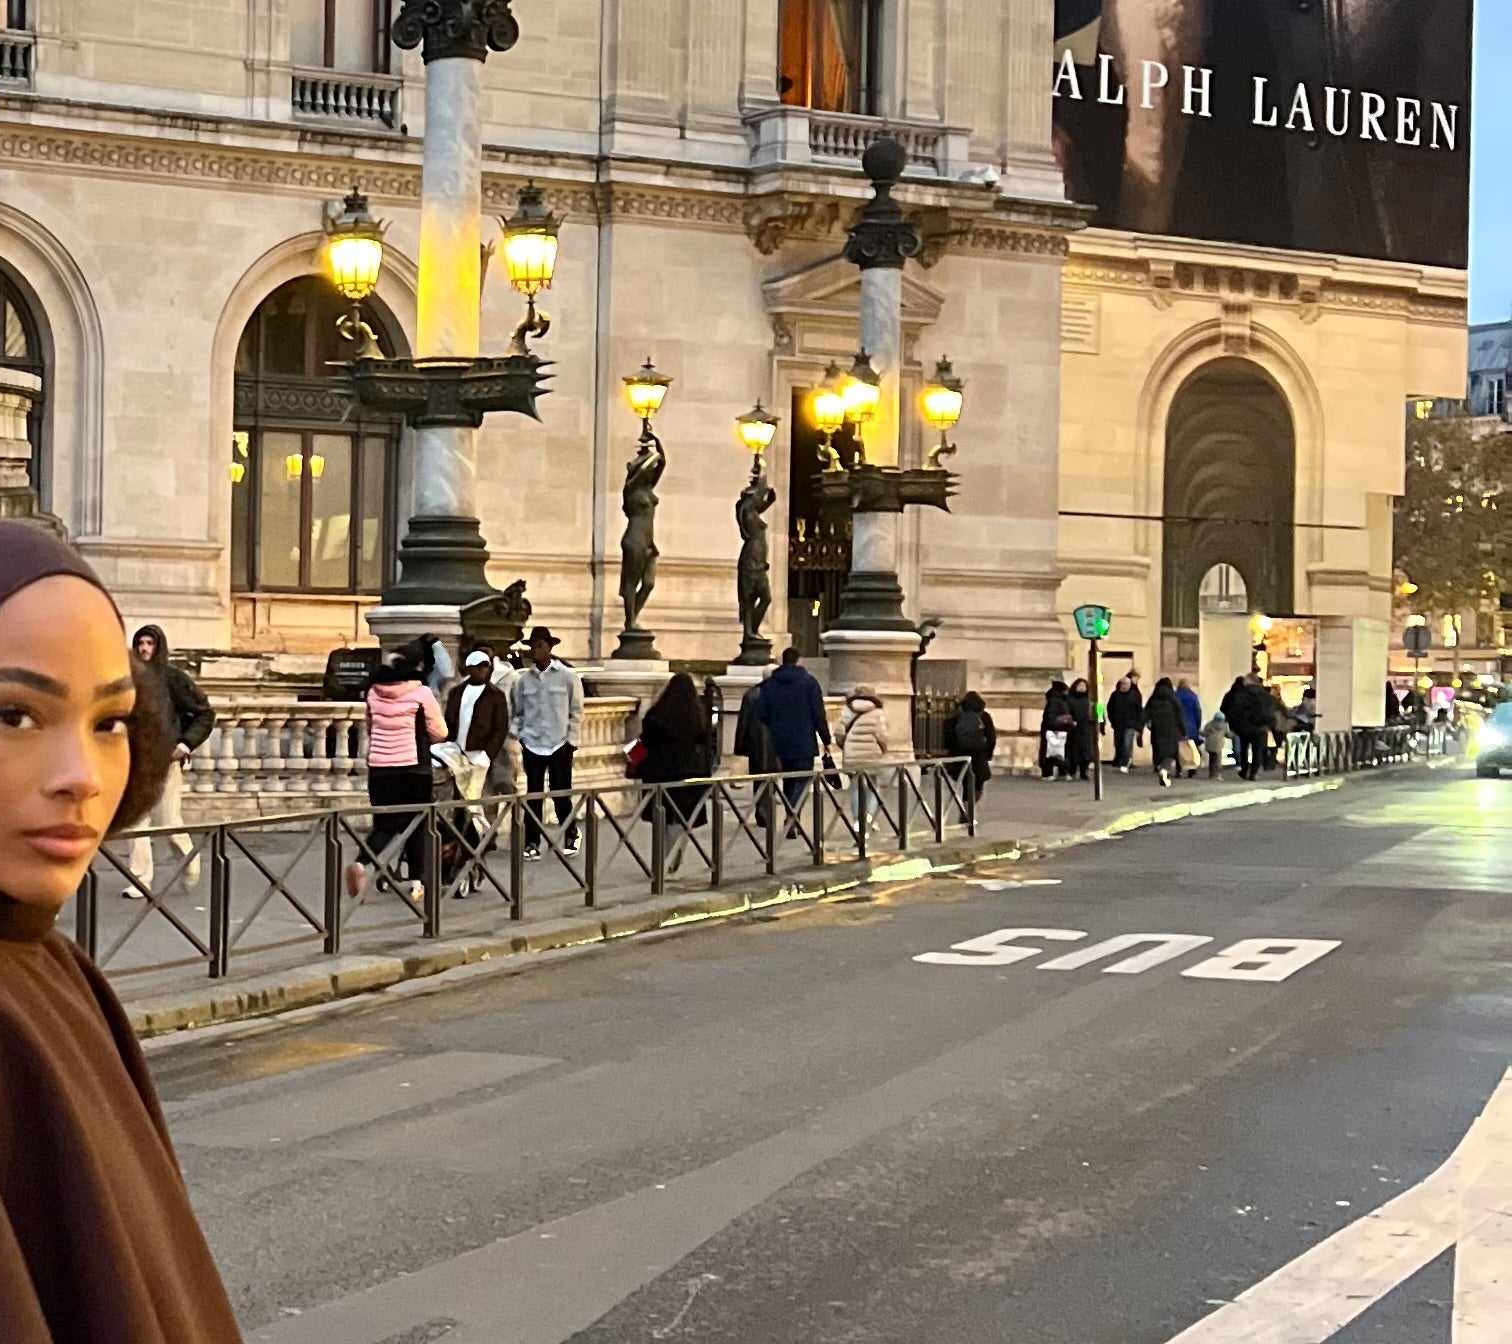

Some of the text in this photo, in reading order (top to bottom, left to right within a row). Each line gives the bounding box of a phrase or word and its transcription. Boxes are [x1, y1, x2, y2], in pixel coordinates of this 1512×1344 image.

[1051, 48, 1458, 151] ALPH LAUREN
[912, 928, 1342, 982] BUS
